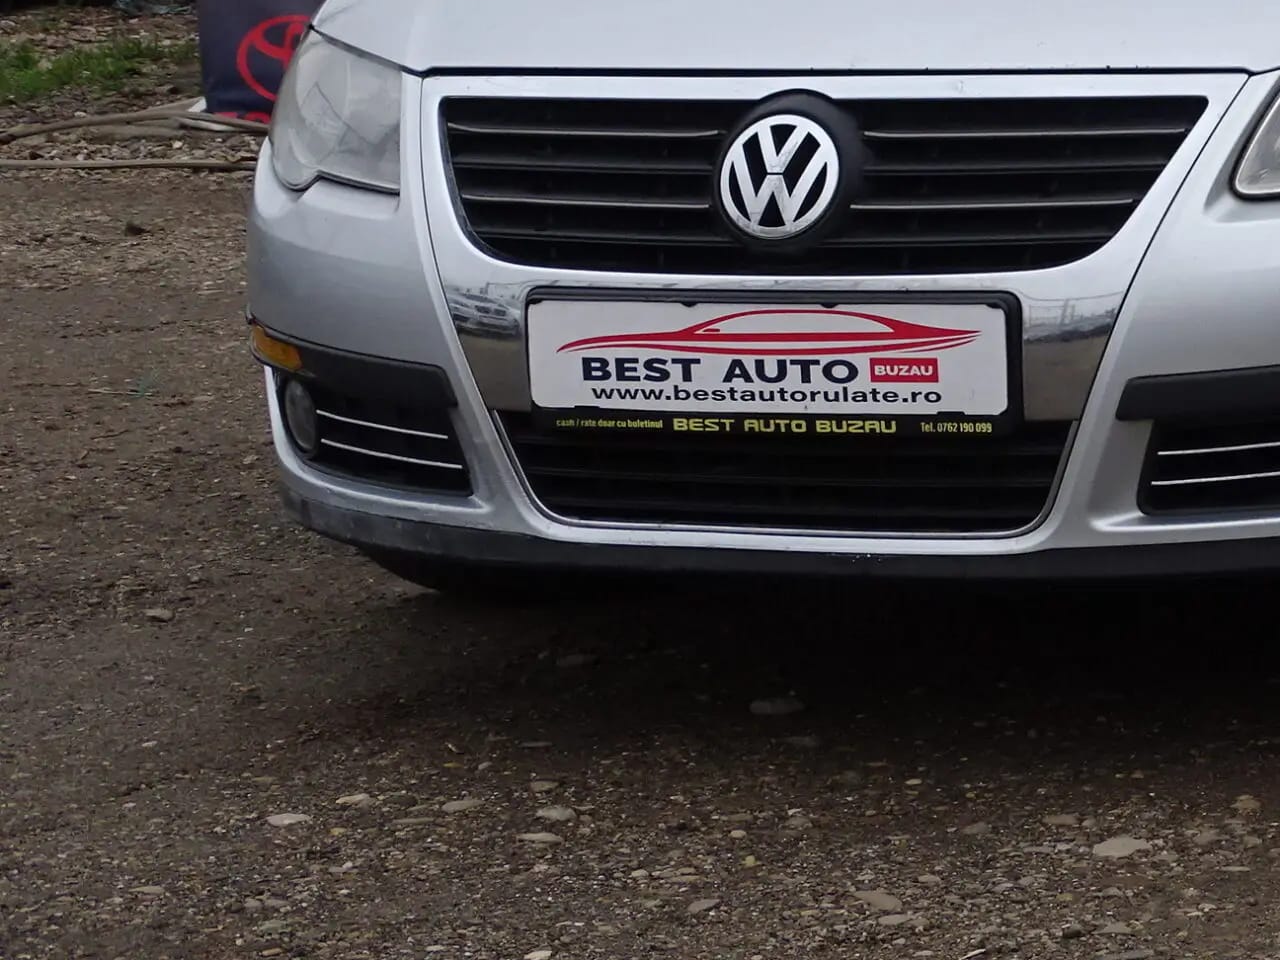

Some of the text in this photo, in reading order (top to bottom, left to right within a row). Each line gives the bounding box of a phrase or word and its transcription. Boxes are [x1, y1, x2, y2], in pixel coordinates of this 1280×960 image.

[581, 357, 933, 384] BEST AUTO BUZAU
[591, 385, 942, 404] www.bestautorulate.ro
[673, 418, 734, 431] BEST
[744, 420, 807, 433] AUTO
[816, 421, 896, 433] BUZAU
[920, 422, 935, 432] Tel.
[937, 423, 957, 432] 0762
[960, 423, 973, 432] 190
[976, 423, 992, 433] 099
